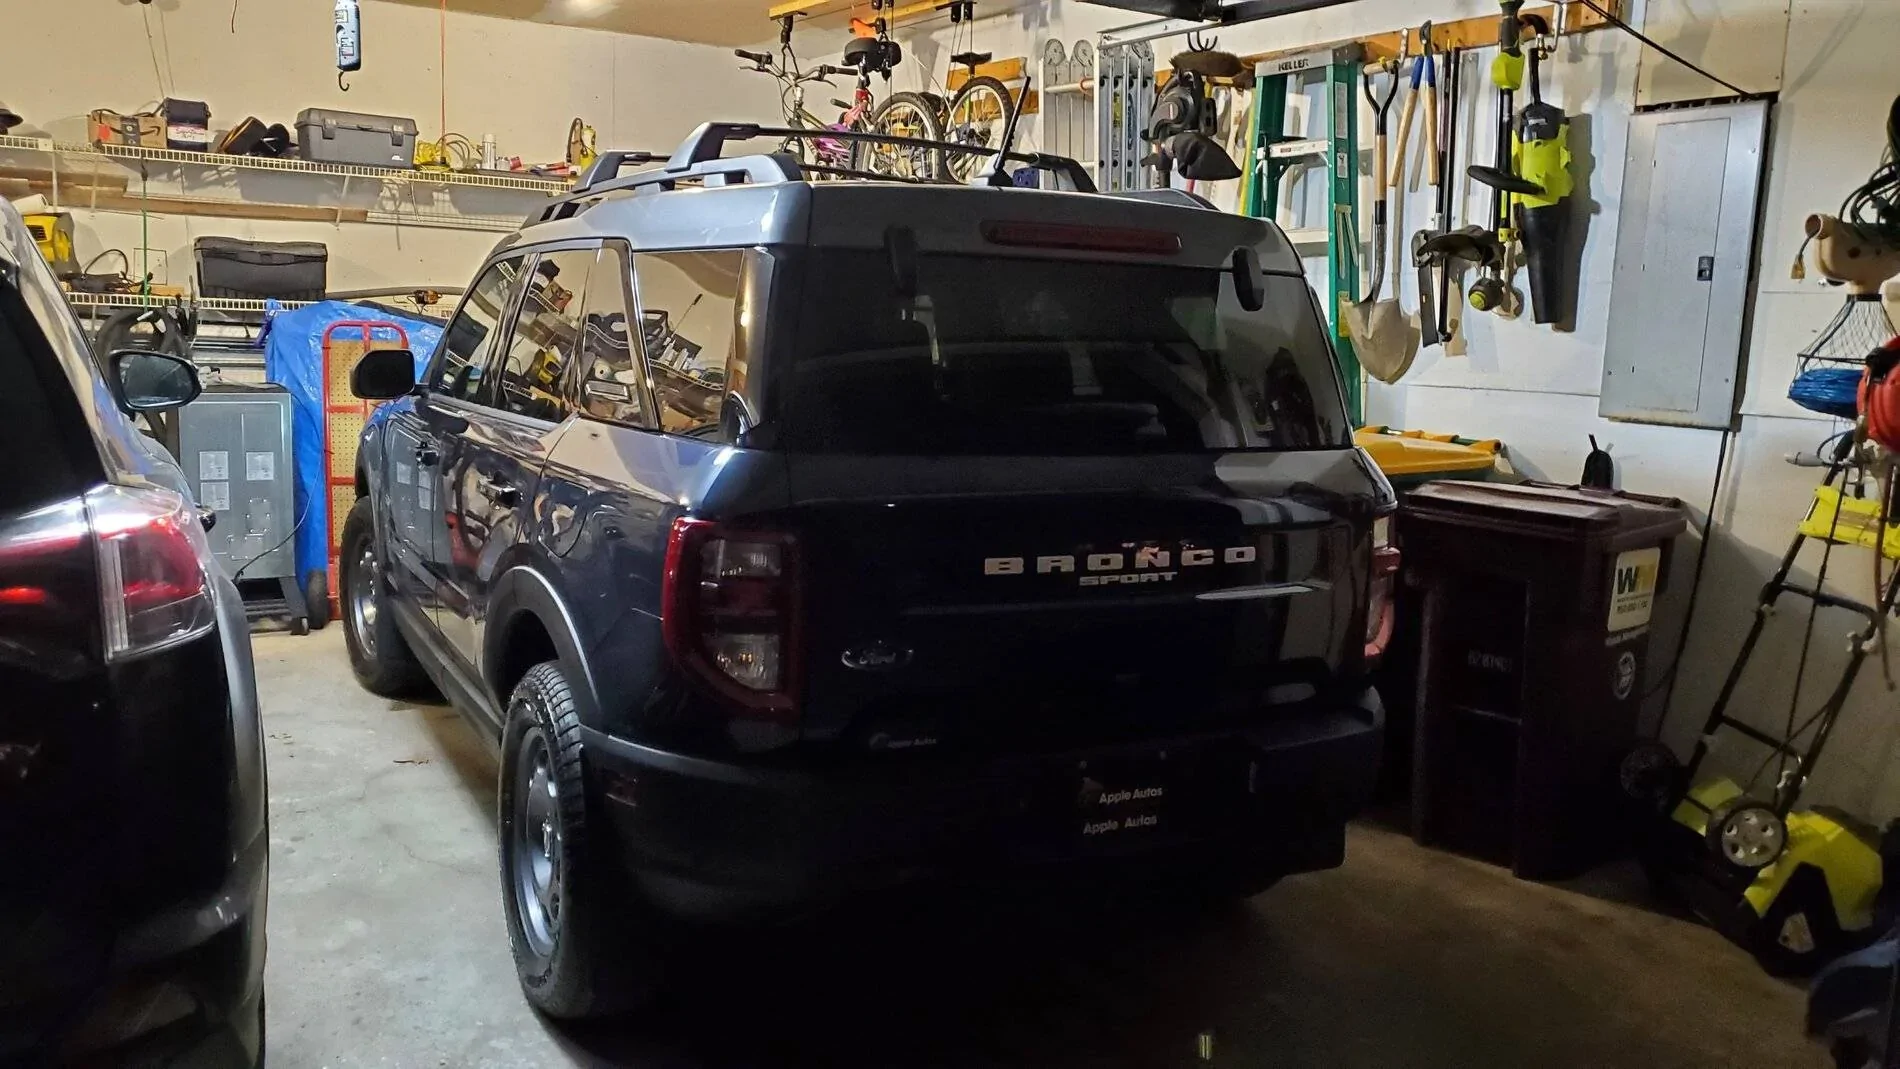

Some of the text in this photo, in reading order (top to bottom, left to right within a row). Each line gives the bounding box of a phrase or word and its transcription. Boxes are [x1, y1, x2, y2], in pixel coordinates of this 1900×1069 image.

[1278, 58, 1309, 72] KELLER
[984, 546, 1257, 576] BRONCO
[1079, 571, 1178, 587] SPORT
[1098, 786, 1164, 805] Apple Autos
[1082, 814, 1158, 835] Apple Autos
